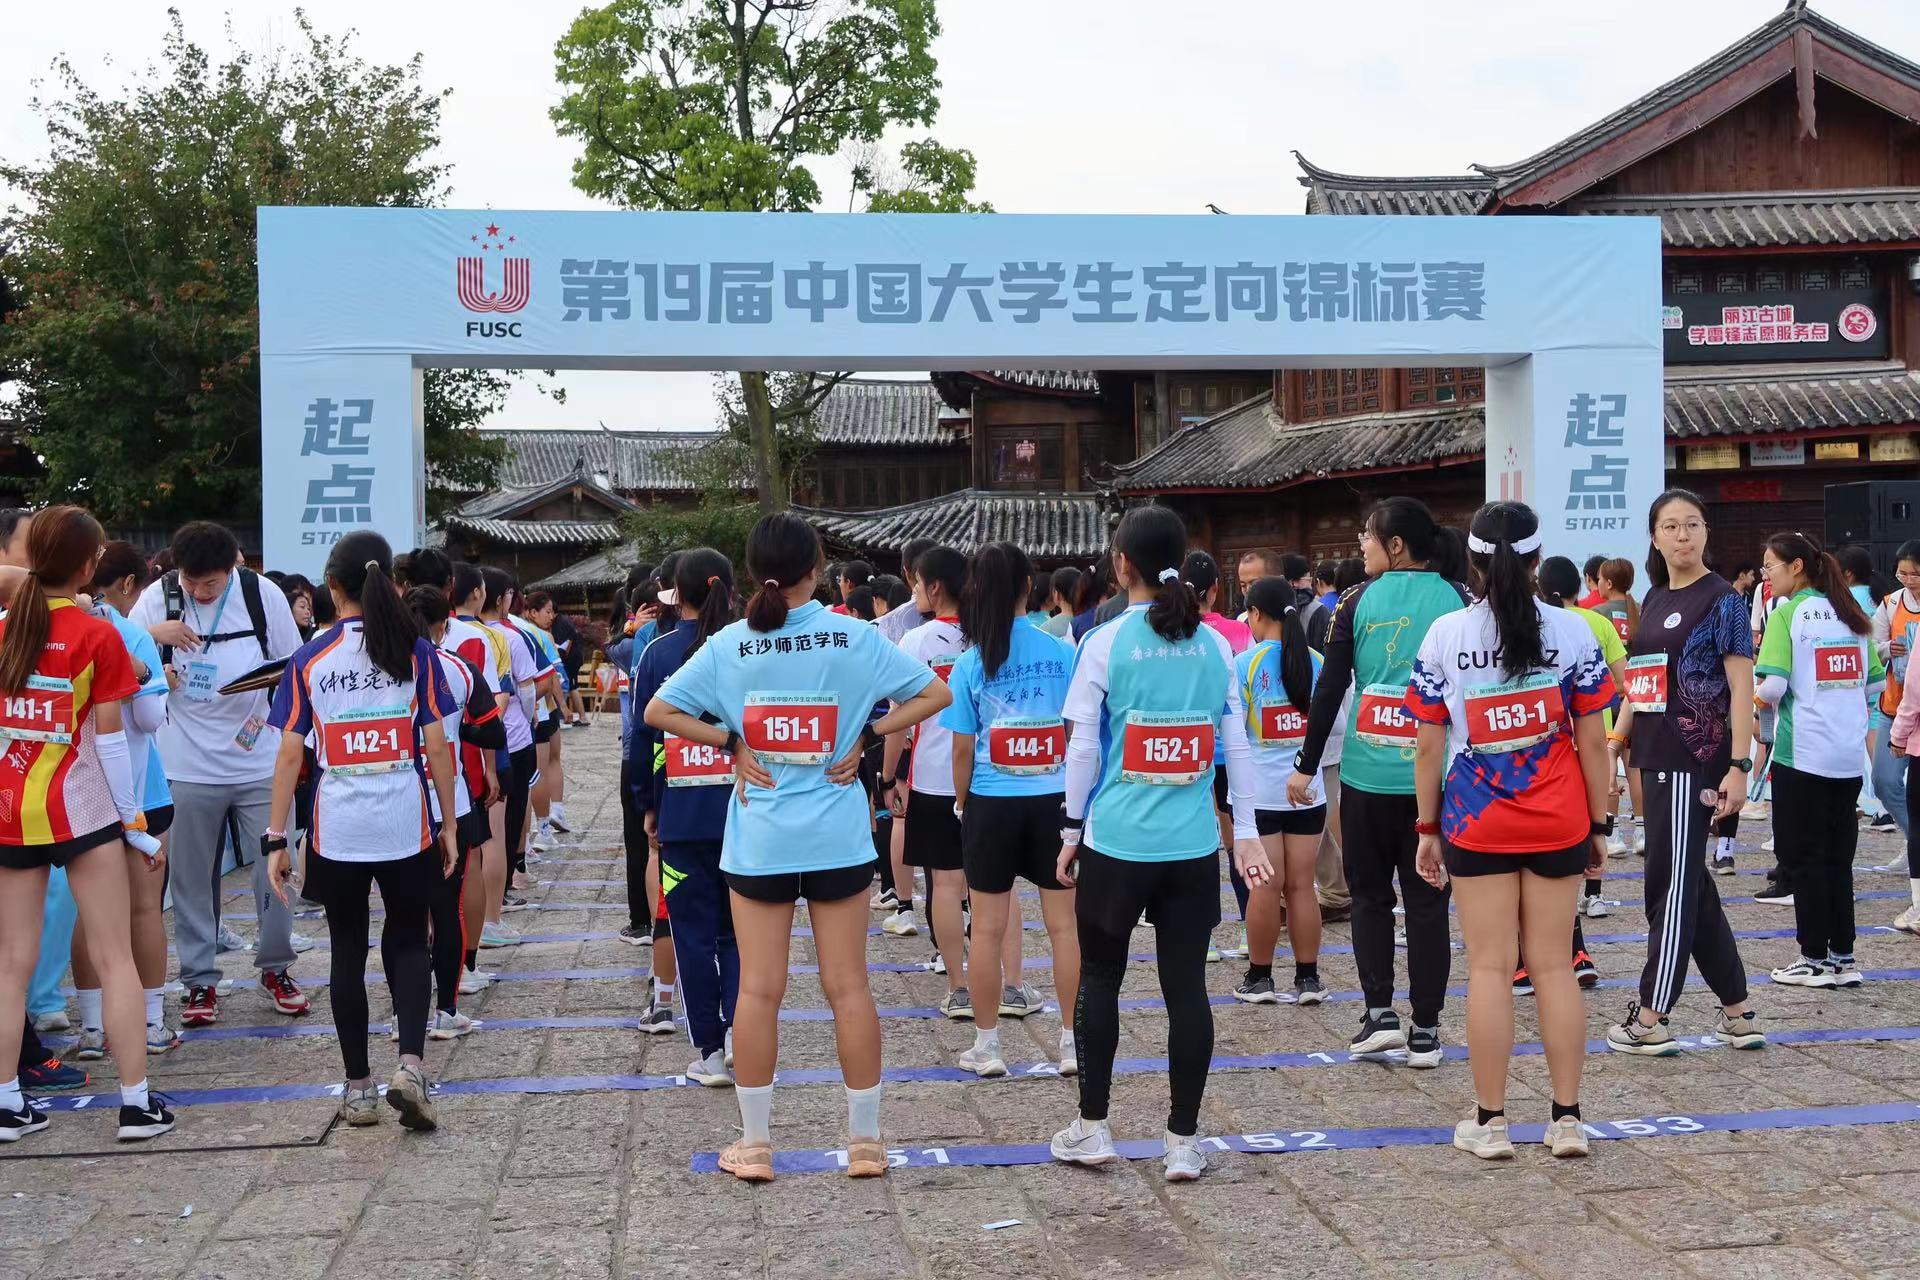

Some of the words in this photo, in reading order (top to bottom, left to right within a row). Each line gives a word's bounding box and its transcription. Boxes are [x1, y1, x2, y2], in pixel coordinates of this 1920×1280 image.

[560, 258, 1485, 324] 第19届中国大学生定向锦标赛
[1724, 307, 1792, 325] 丽江古城
[466, 322, 522, 338] FUSC
[1689, 324, 1828, 343] 学雷锋志愿服务点
[300, 398, 375, 523] 起点
[1563, 393, 1630, 510] 起点
[1565, 517, 1630, 530] START
[301, 532, 342, 545] STA
[44, 642, 66, 651] RING
[738, 631, 849, 658] 长沙师范学院
[1457, 650, 1560, 670] CUHZ
[1827, 654, 1857, 673] 137-1
[1005, 687, 1044, 704] 定向队
[1628, 675, 1658, 695] 146-1
[5, 696, 53, 722] 141-1
[1484, 700, 1547, 732] 153-1
[763, 716, 820, 742] 151-1
[1274, 711, 1308, 732] 135-
[342, 728, 398, 755] 142-1
[1006, 736, 1053, 758] 144-1
[1142, 736, 1200, 763] 152-1
[28, 1095, 96, 1110] 41
[1580, 1115, 1705, 1138] 153
[1200, 1131, 1337, 1150] 152
[824, 1147, 950, 1168] 151
